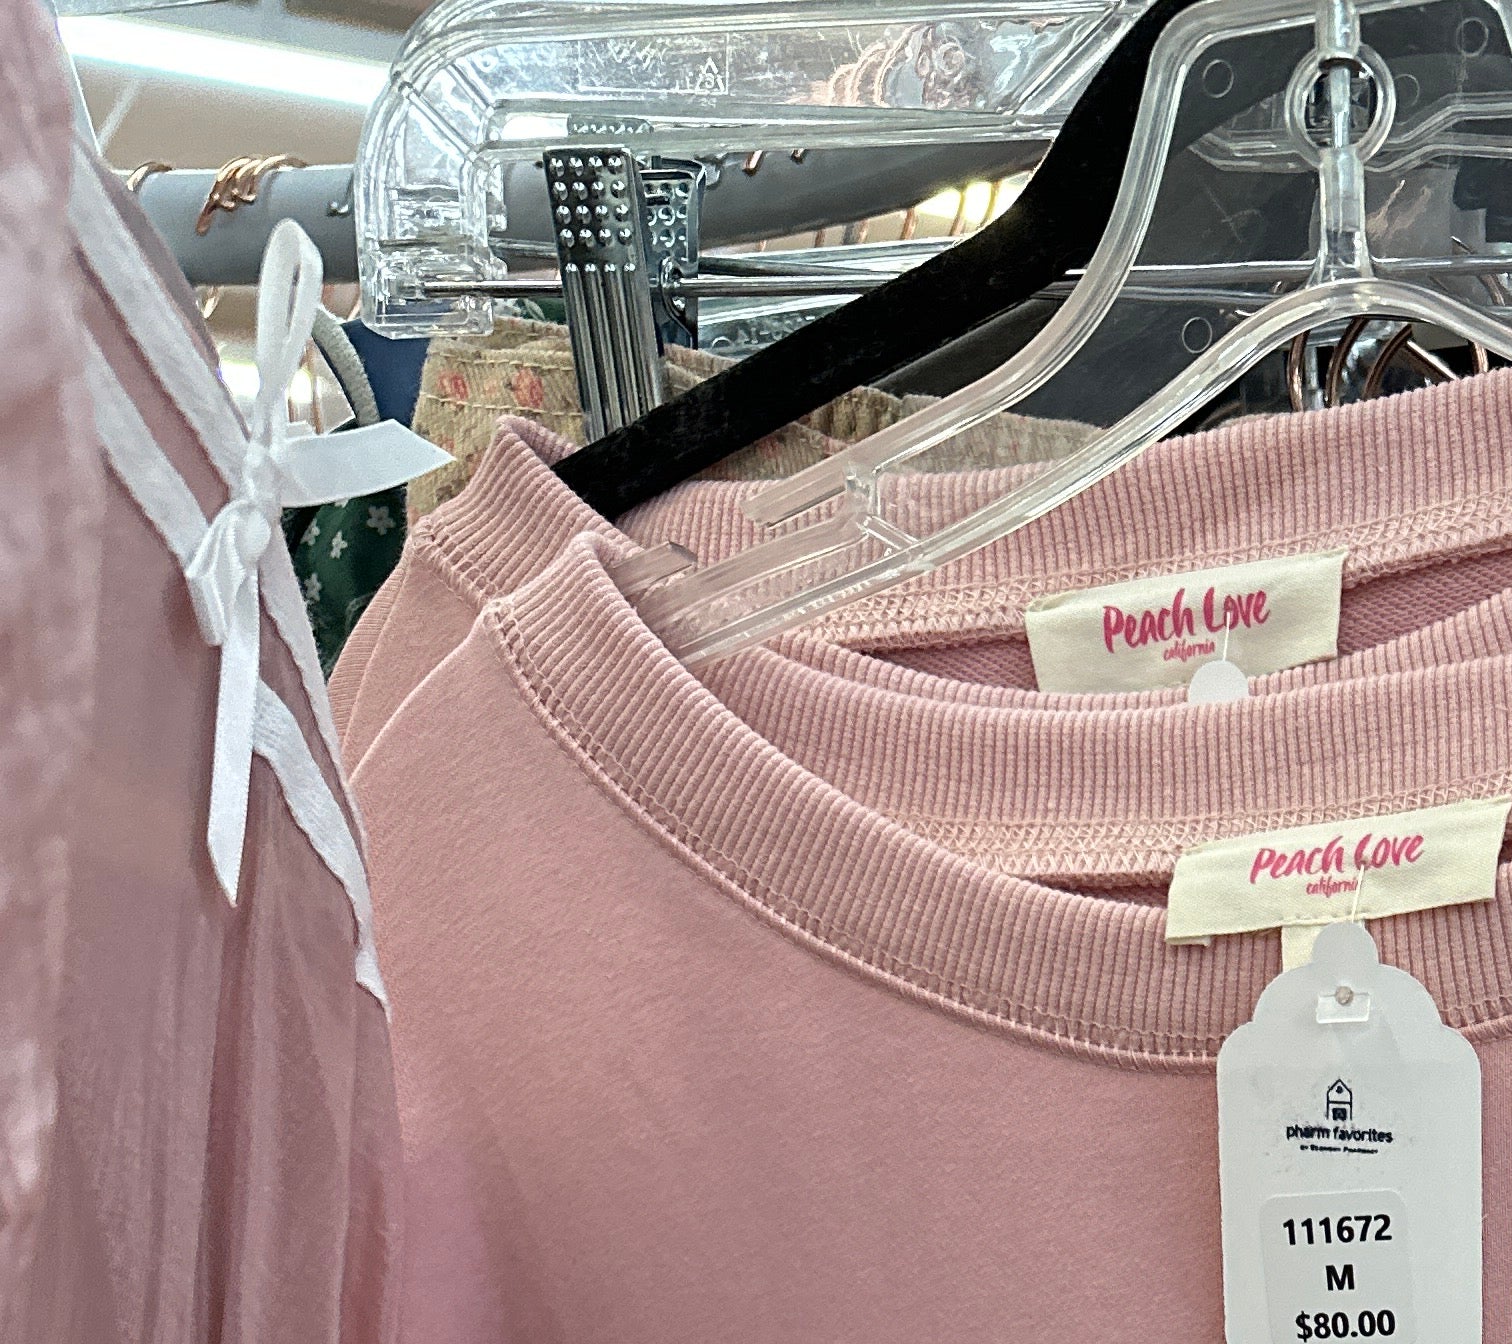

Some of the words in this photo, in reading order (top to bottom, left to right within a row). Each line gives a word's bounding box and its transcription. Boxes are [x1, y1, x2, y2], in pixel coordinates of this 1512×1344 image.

[1103, 587, 1196, 654] Peach
[1203, 586, 1270, 633] Love
[1164, 640, 1215, 662] california
[1250, 835, 1345, 884] Peach
[1354, 833, 1425, 871] Love
[1286, 1124, 1331, 1141] pharm
[1333, 1126, 1393, 1143] favorites
[1283, 1214, 1393, 1246] 111672
[1326, 1264, 1355, 1291] M
[1295, 1309, 1396, 1343] $80.00
